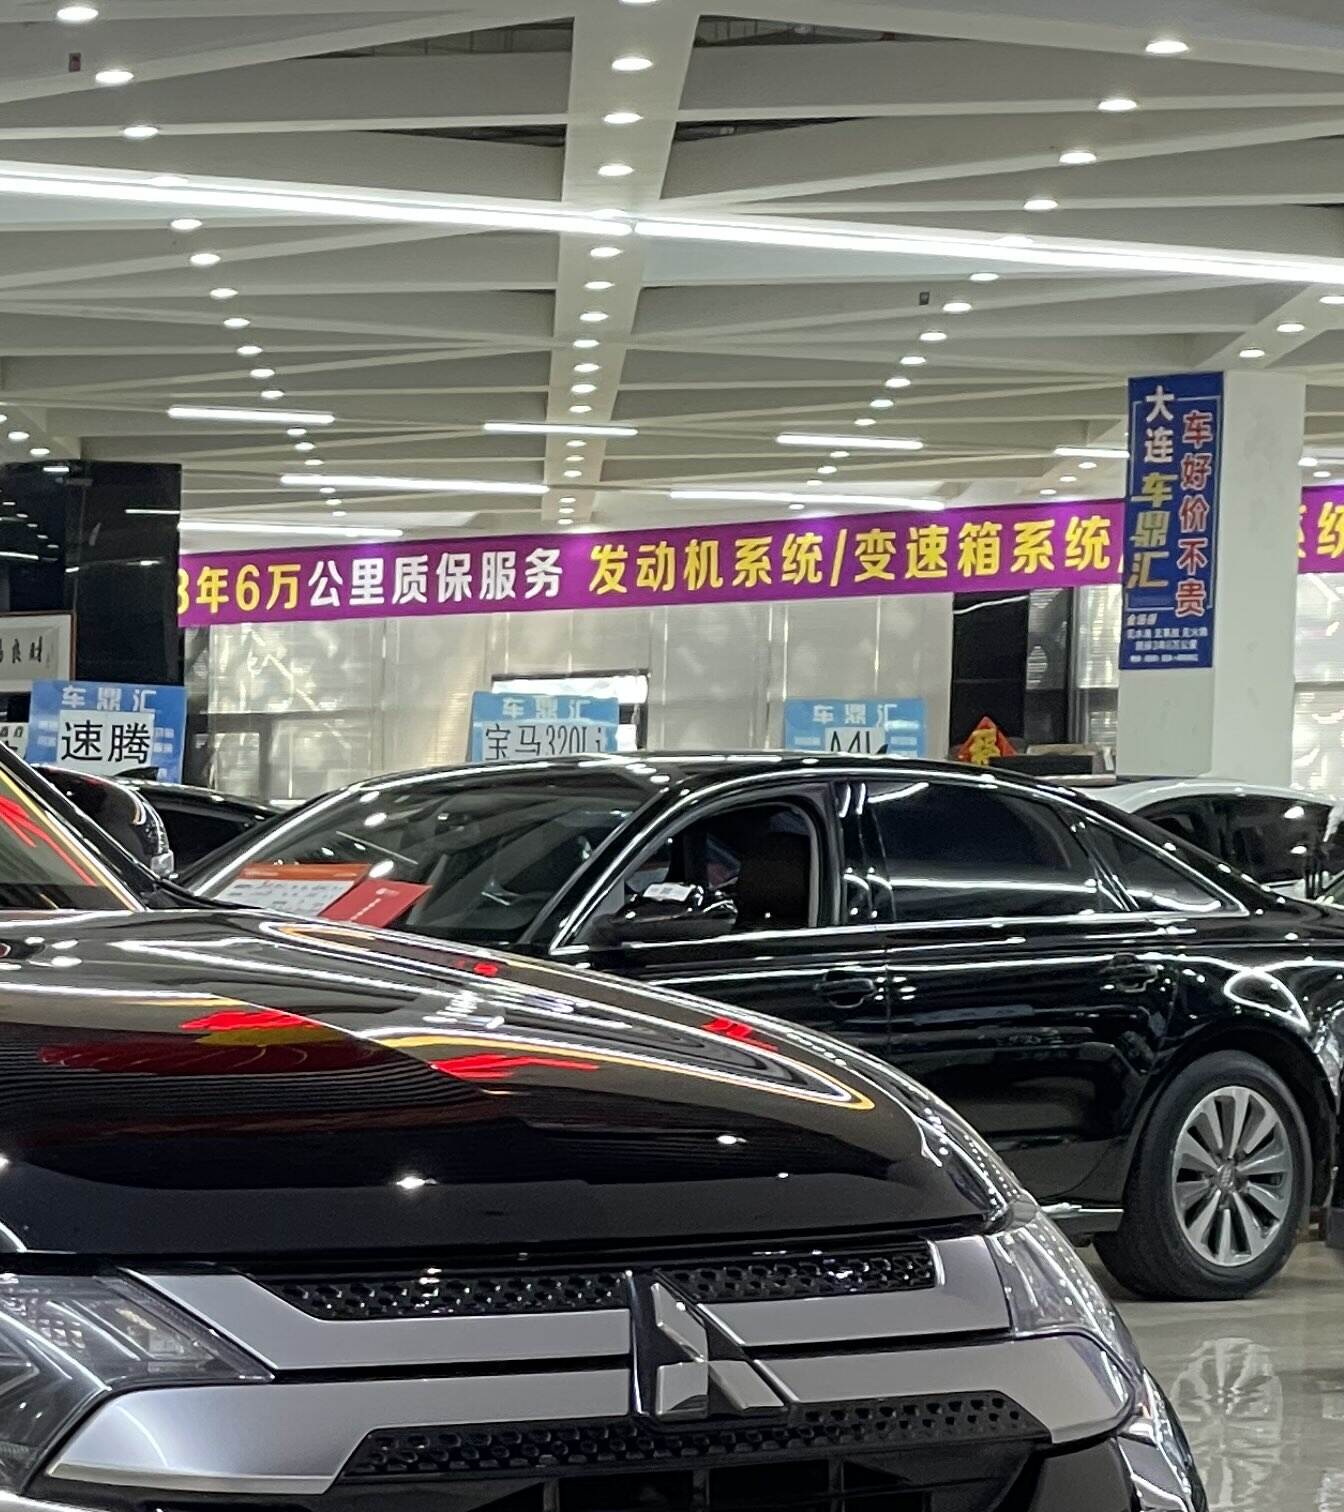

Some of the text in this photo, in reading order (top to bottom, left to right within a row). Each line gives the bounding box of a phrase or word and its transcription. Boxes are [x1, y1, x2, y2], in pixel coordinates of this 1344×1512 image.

[1126, 385, 1178, 589] 大连车鼎汇
[1174, 409, 1213, 618] 车好价不贵
[588, 514, 1124, 596] 发动机系统/变速箱系统
[61, 686, 158, 713] 车鼎汇
[61, 719, 152, 765] 速腾
